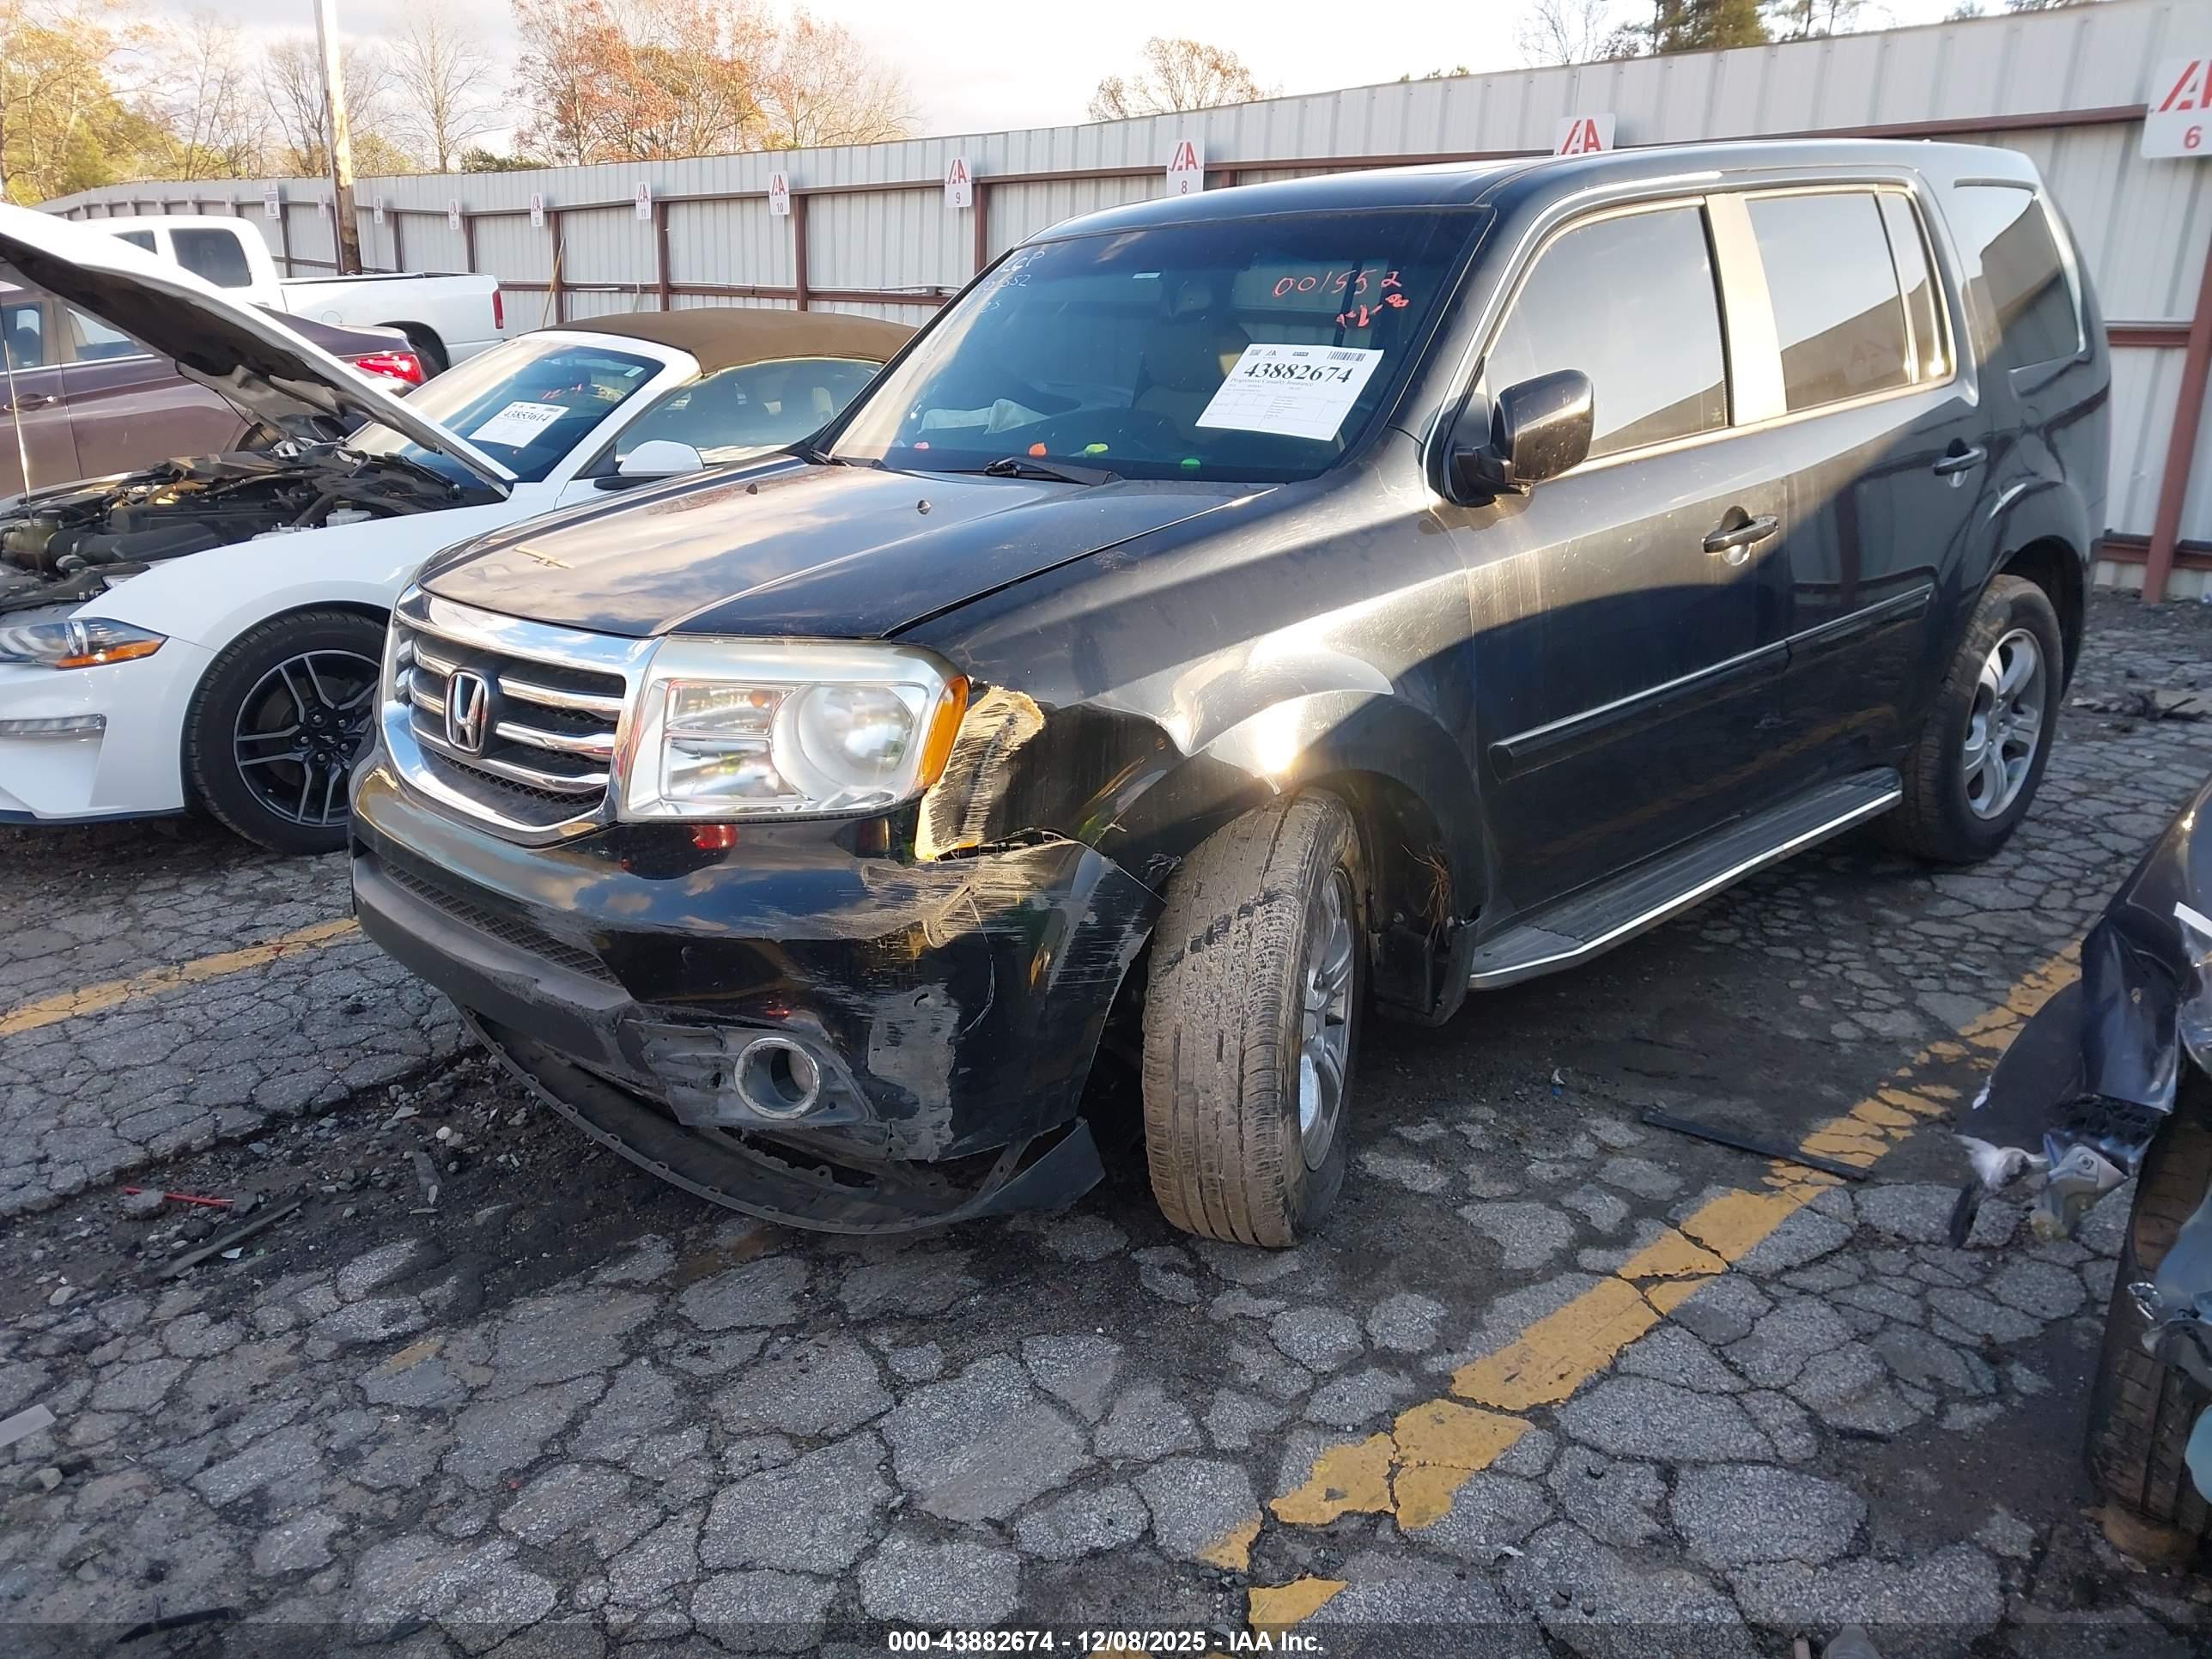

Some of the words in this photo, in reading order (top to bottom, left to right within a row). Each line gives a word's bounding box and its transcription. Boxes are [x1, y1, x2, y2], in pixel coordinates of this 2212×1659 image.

[2184, 125, 2203, 149] 6
[1181, 179, 1188, 194] 8
[955, 191, 962, 204] 9
[775, 202, 785, 214] 10
[1243, 362, 1354, 384] 43882674
